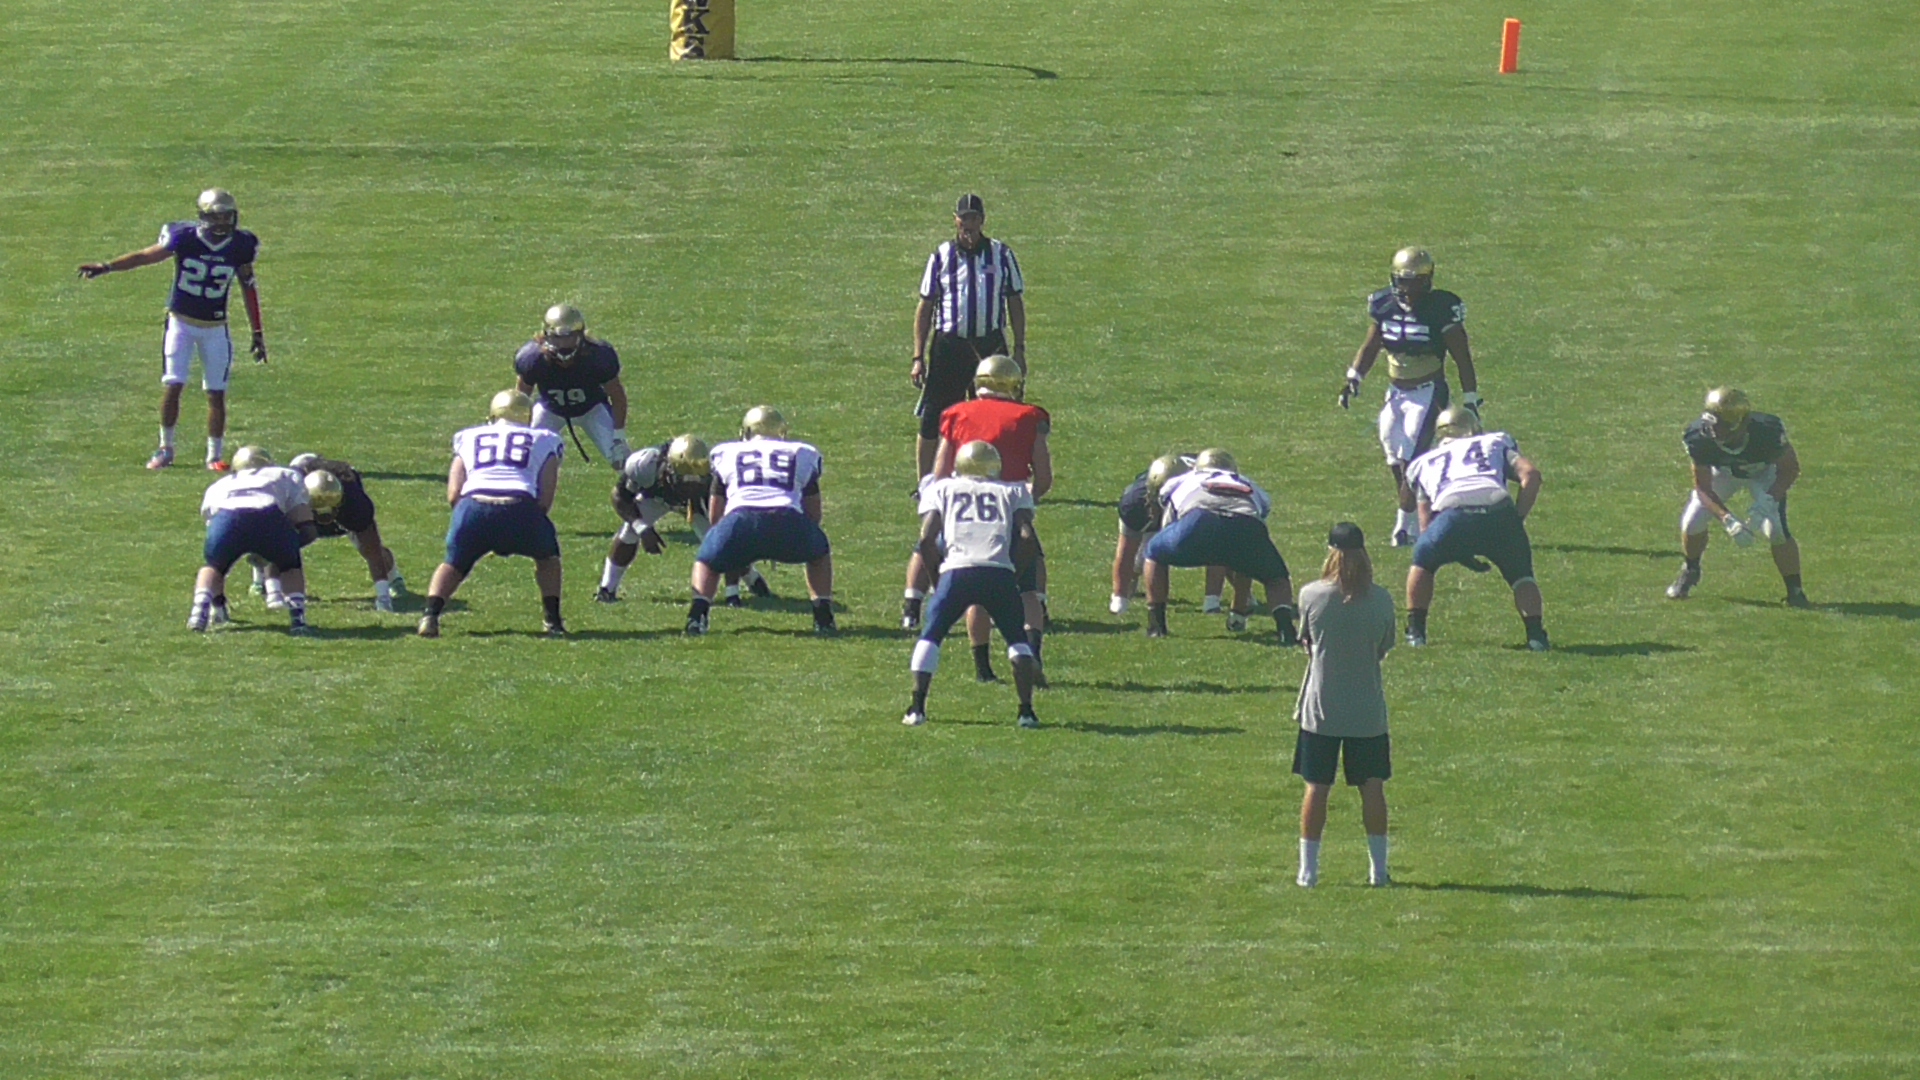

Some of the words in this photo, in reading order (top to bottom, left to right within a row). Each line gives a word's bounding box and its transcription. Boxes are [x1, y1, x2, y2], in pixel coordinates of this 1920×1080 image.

[680, 0, 709, 59] KS
[178, 258, 234, 299] 23
[474, 432, 534, 470] 68
[736, 448, 797, 492] 69
[1428, 440, 1492, 482] 74
[953, 492, 999, 523] 26
